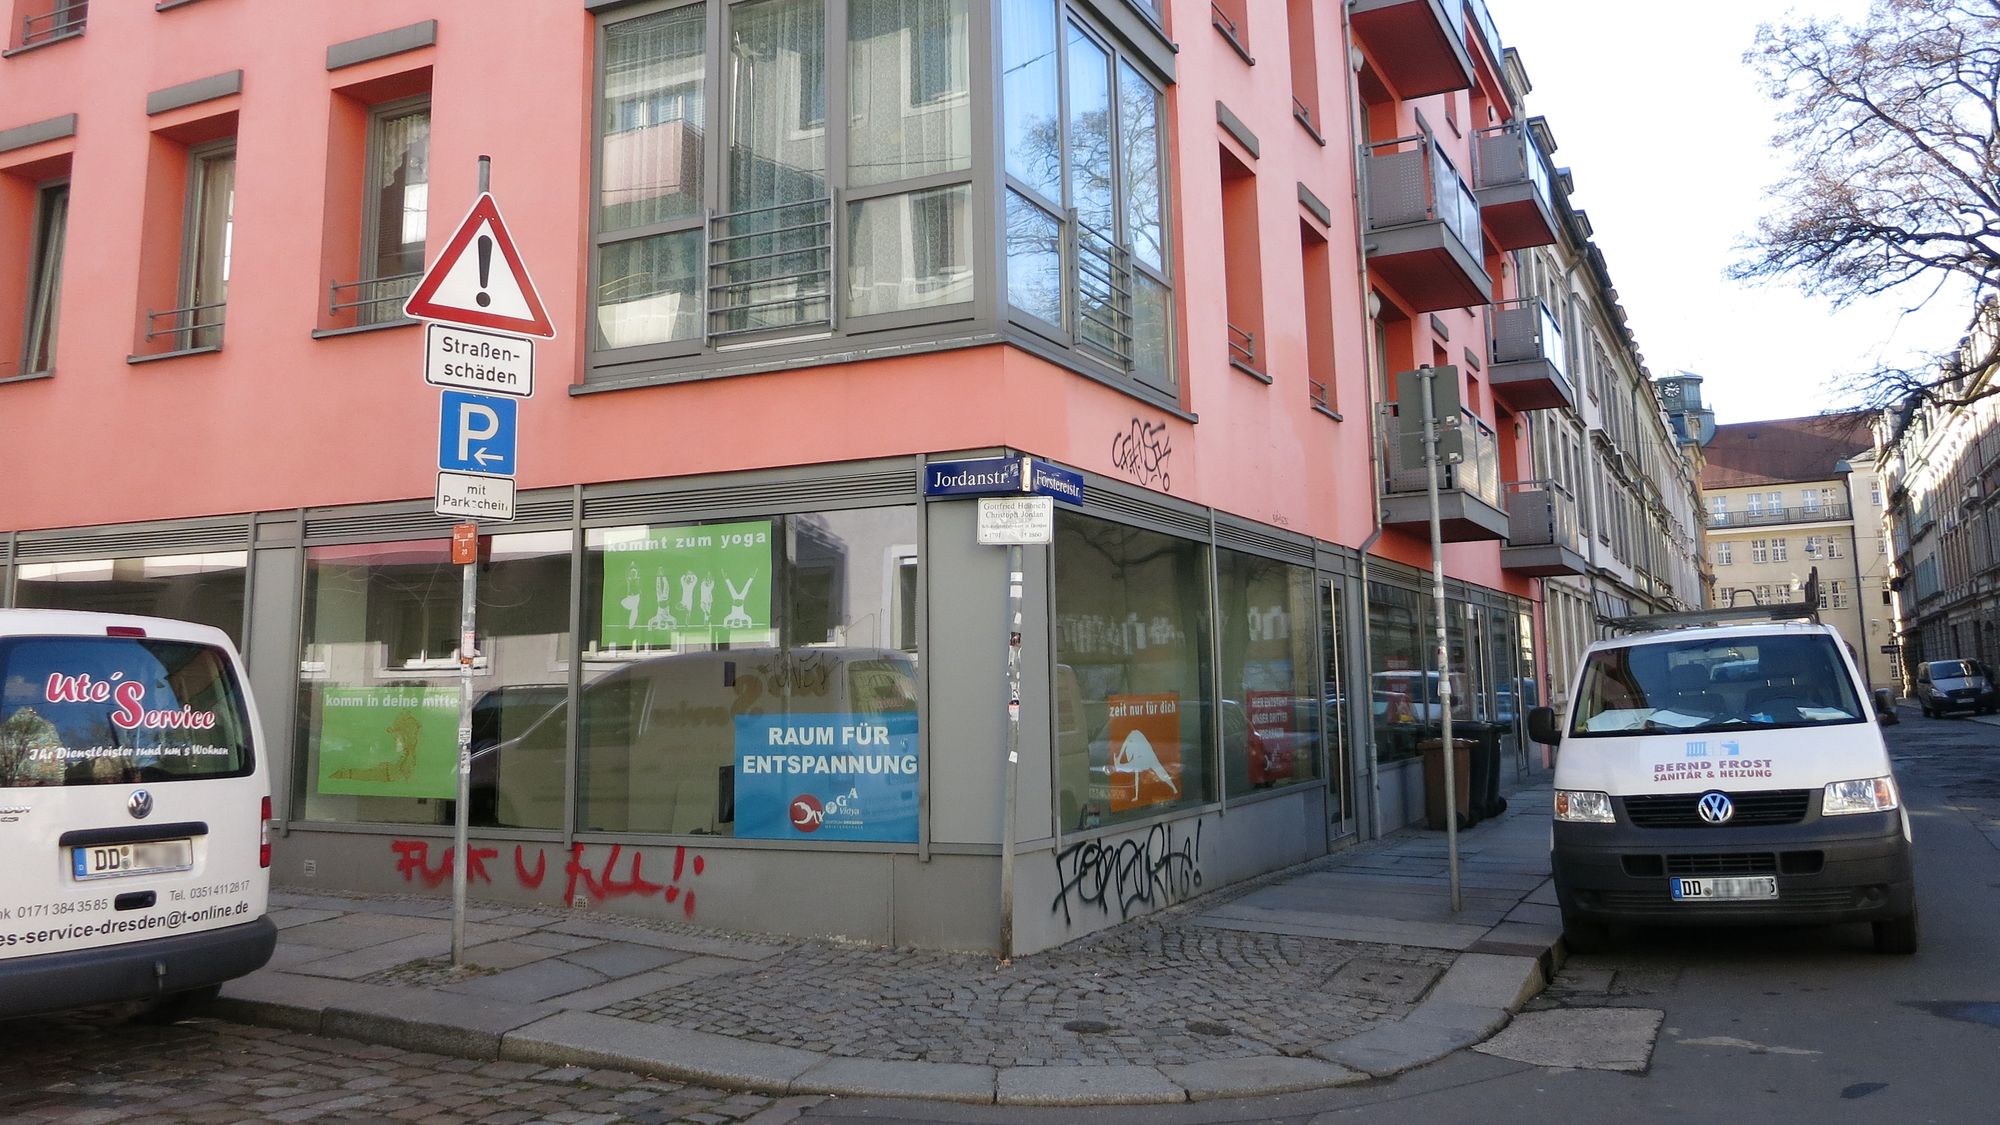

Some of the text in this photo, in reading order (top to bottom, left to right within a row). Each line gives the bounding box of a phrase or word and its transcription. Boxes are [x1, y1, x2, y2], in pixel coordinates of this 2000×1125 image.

[442, 336, 520, 361] Straßen-
[443, 362, 517, 385] schäden
[458, 402, 499, 461] P
[933, 470, 1010, 488] Jordanstr.
[1036, 469, 1082, 498] Förstereistr.
[466, 484, 486, 495] mit
[983, 502, 1015, 511] Gottfried
[607, 532, 766, 552] kommt zum yoga
[326, 695, 363, 707] komm
[367, 695, 378, 707] in
[383, 695, 418, 707] deine
[1109, 700, 1176, 717] zeit nur für dich
[769, 722, 890, 746] RAUM FÜR
[29, 749, 54, 761] Ihr
[56, 746, 133, 760] Dienstleister
[136, 745, 161, 757] rund
[192, 744, 229, 756] Wohnen
[743, 755, 918, 774] ENTSPANNUNG
[1654, 759, 1772, 772] BERND FROST
[1653, 771, 1702, 782] SANITÄR
[1719, 769, 1772, 778] HEIZUNG
[95, 848, 119, 870] DD
[514, 843, 546, 888] U
[170, 890, 185, 901] Tel.
[1682, 880, 1701, 896] DD
